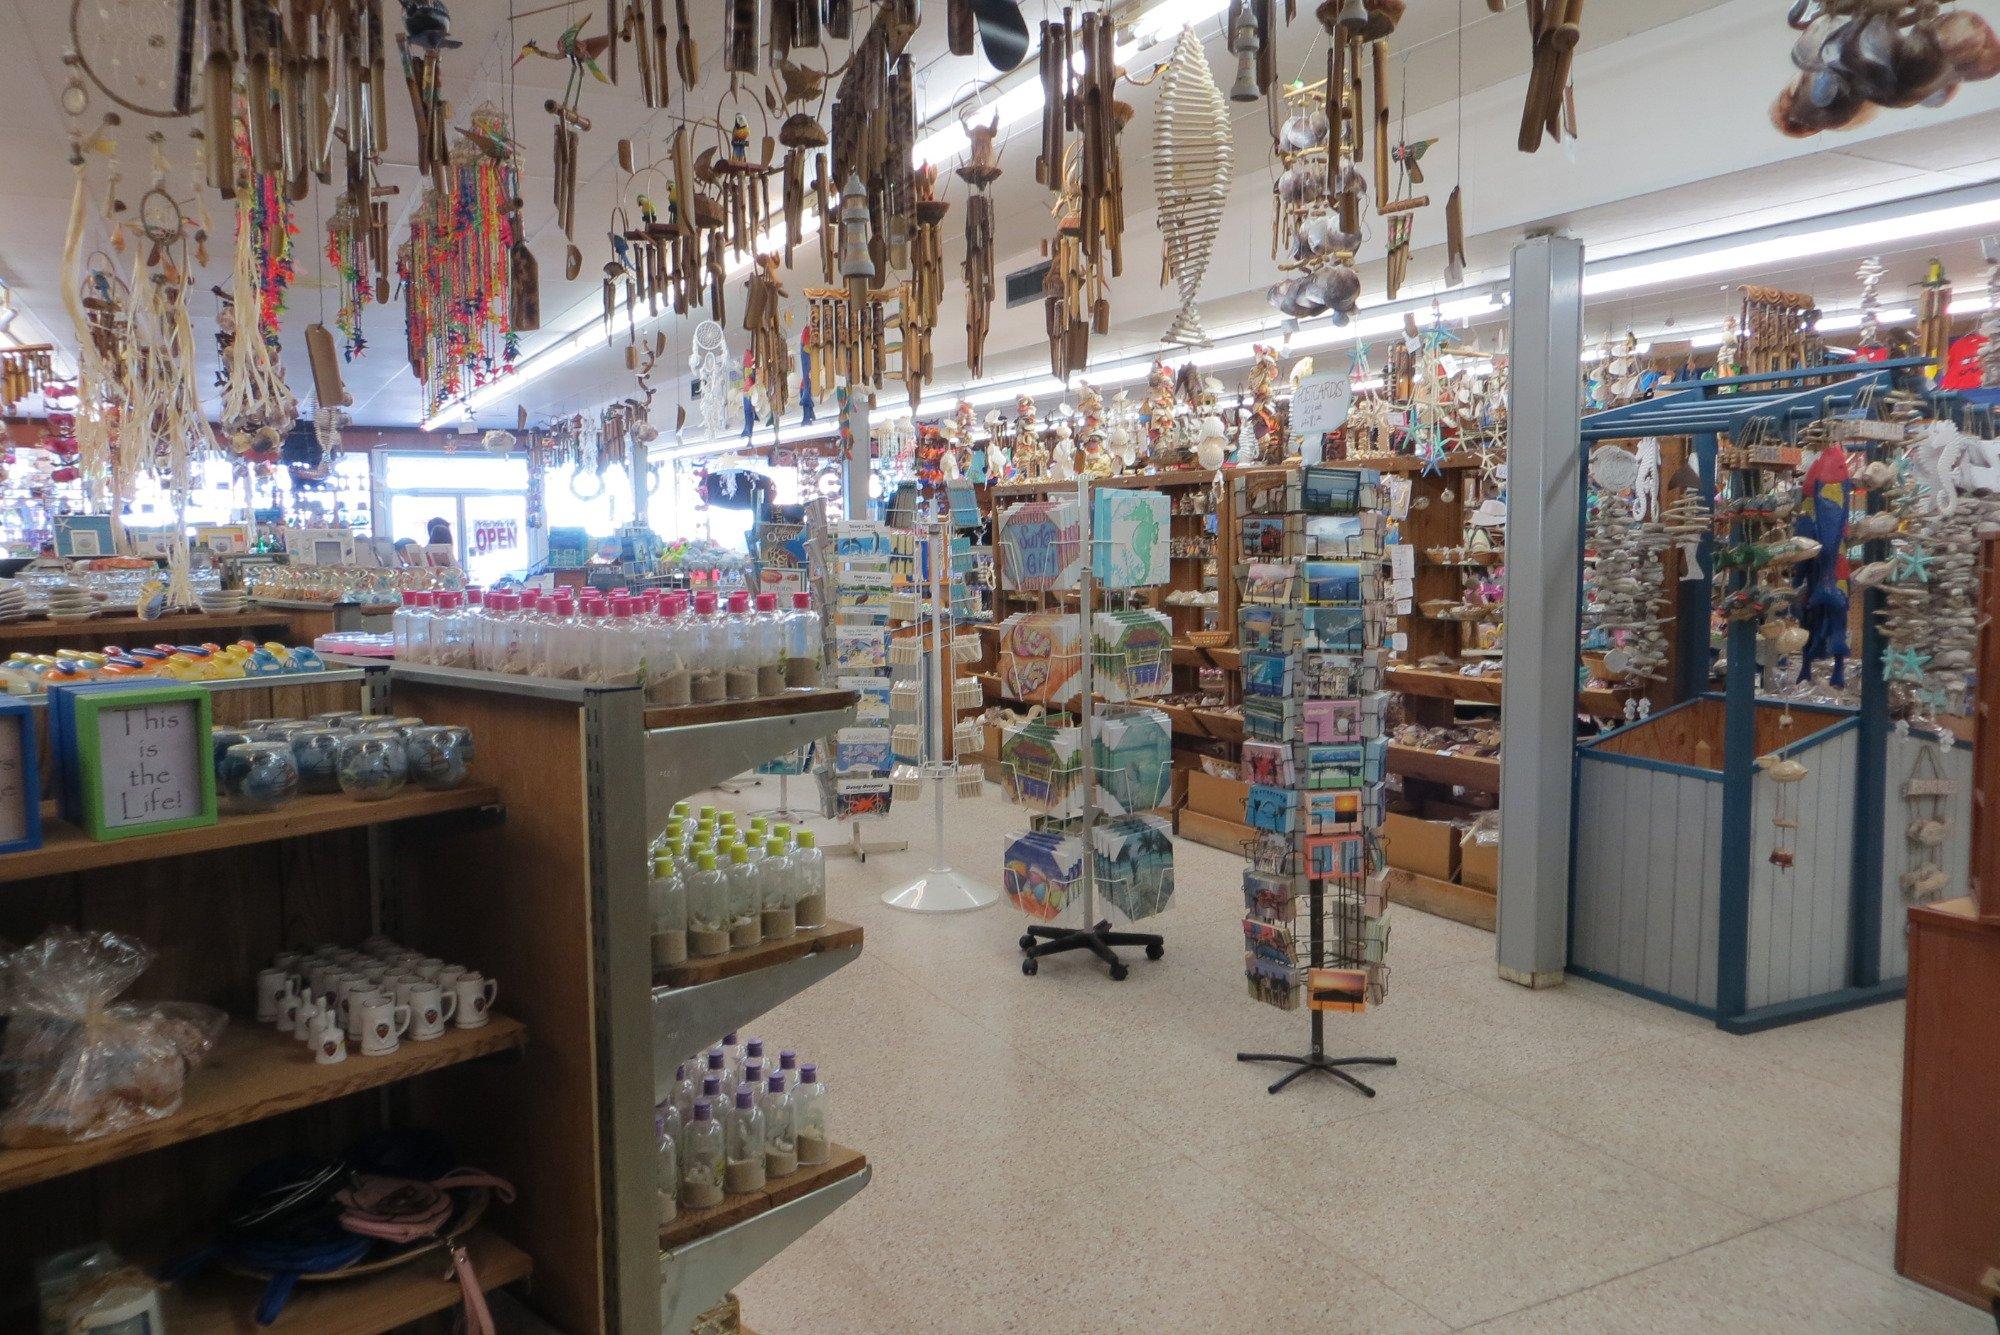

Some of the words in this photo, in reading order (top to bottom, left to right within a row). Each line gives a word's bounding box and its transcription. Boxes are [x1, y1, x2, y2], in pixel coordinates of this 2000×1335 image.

[476, 528, 517, 551] OPEN
[1019, 524, 1057, 549] Surfer
[1027, 553, 1055, 575] Girl
[113, 707, 180, 736] This
[139, 740, 160, 758] is
[128, 763, 171, 787] the
[120, 788, 182, 820] Life!
